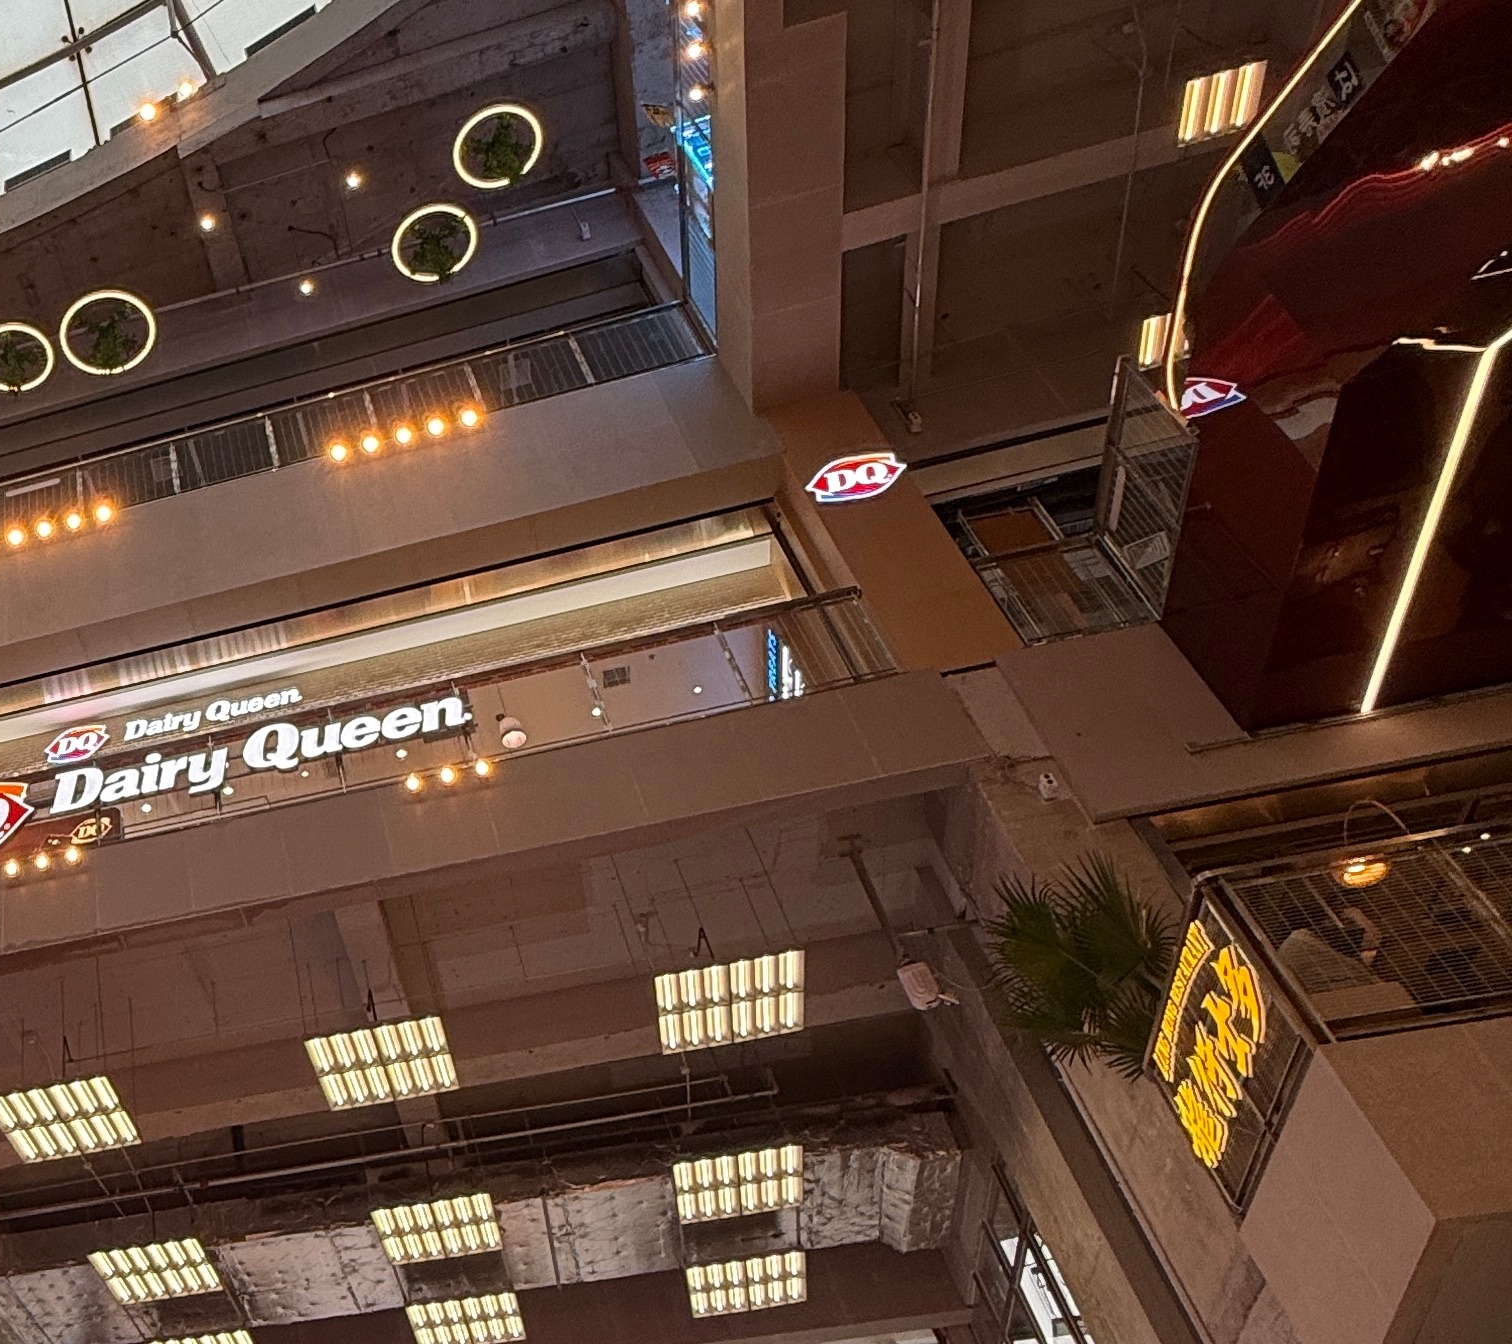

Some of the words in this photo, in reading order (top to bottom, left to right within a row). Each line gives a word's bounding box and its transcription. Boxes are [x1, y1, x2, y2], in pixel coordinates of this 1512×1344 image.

[825, 461, 889, 495] DQ
[49, 744, 229, 815] Dairy
[242, 694, 468, 771] Queen
[56, 729, 100, 757] DQ
[123, 707, 202, 743] Dairy
[205, 685, 302, 723] Queen
